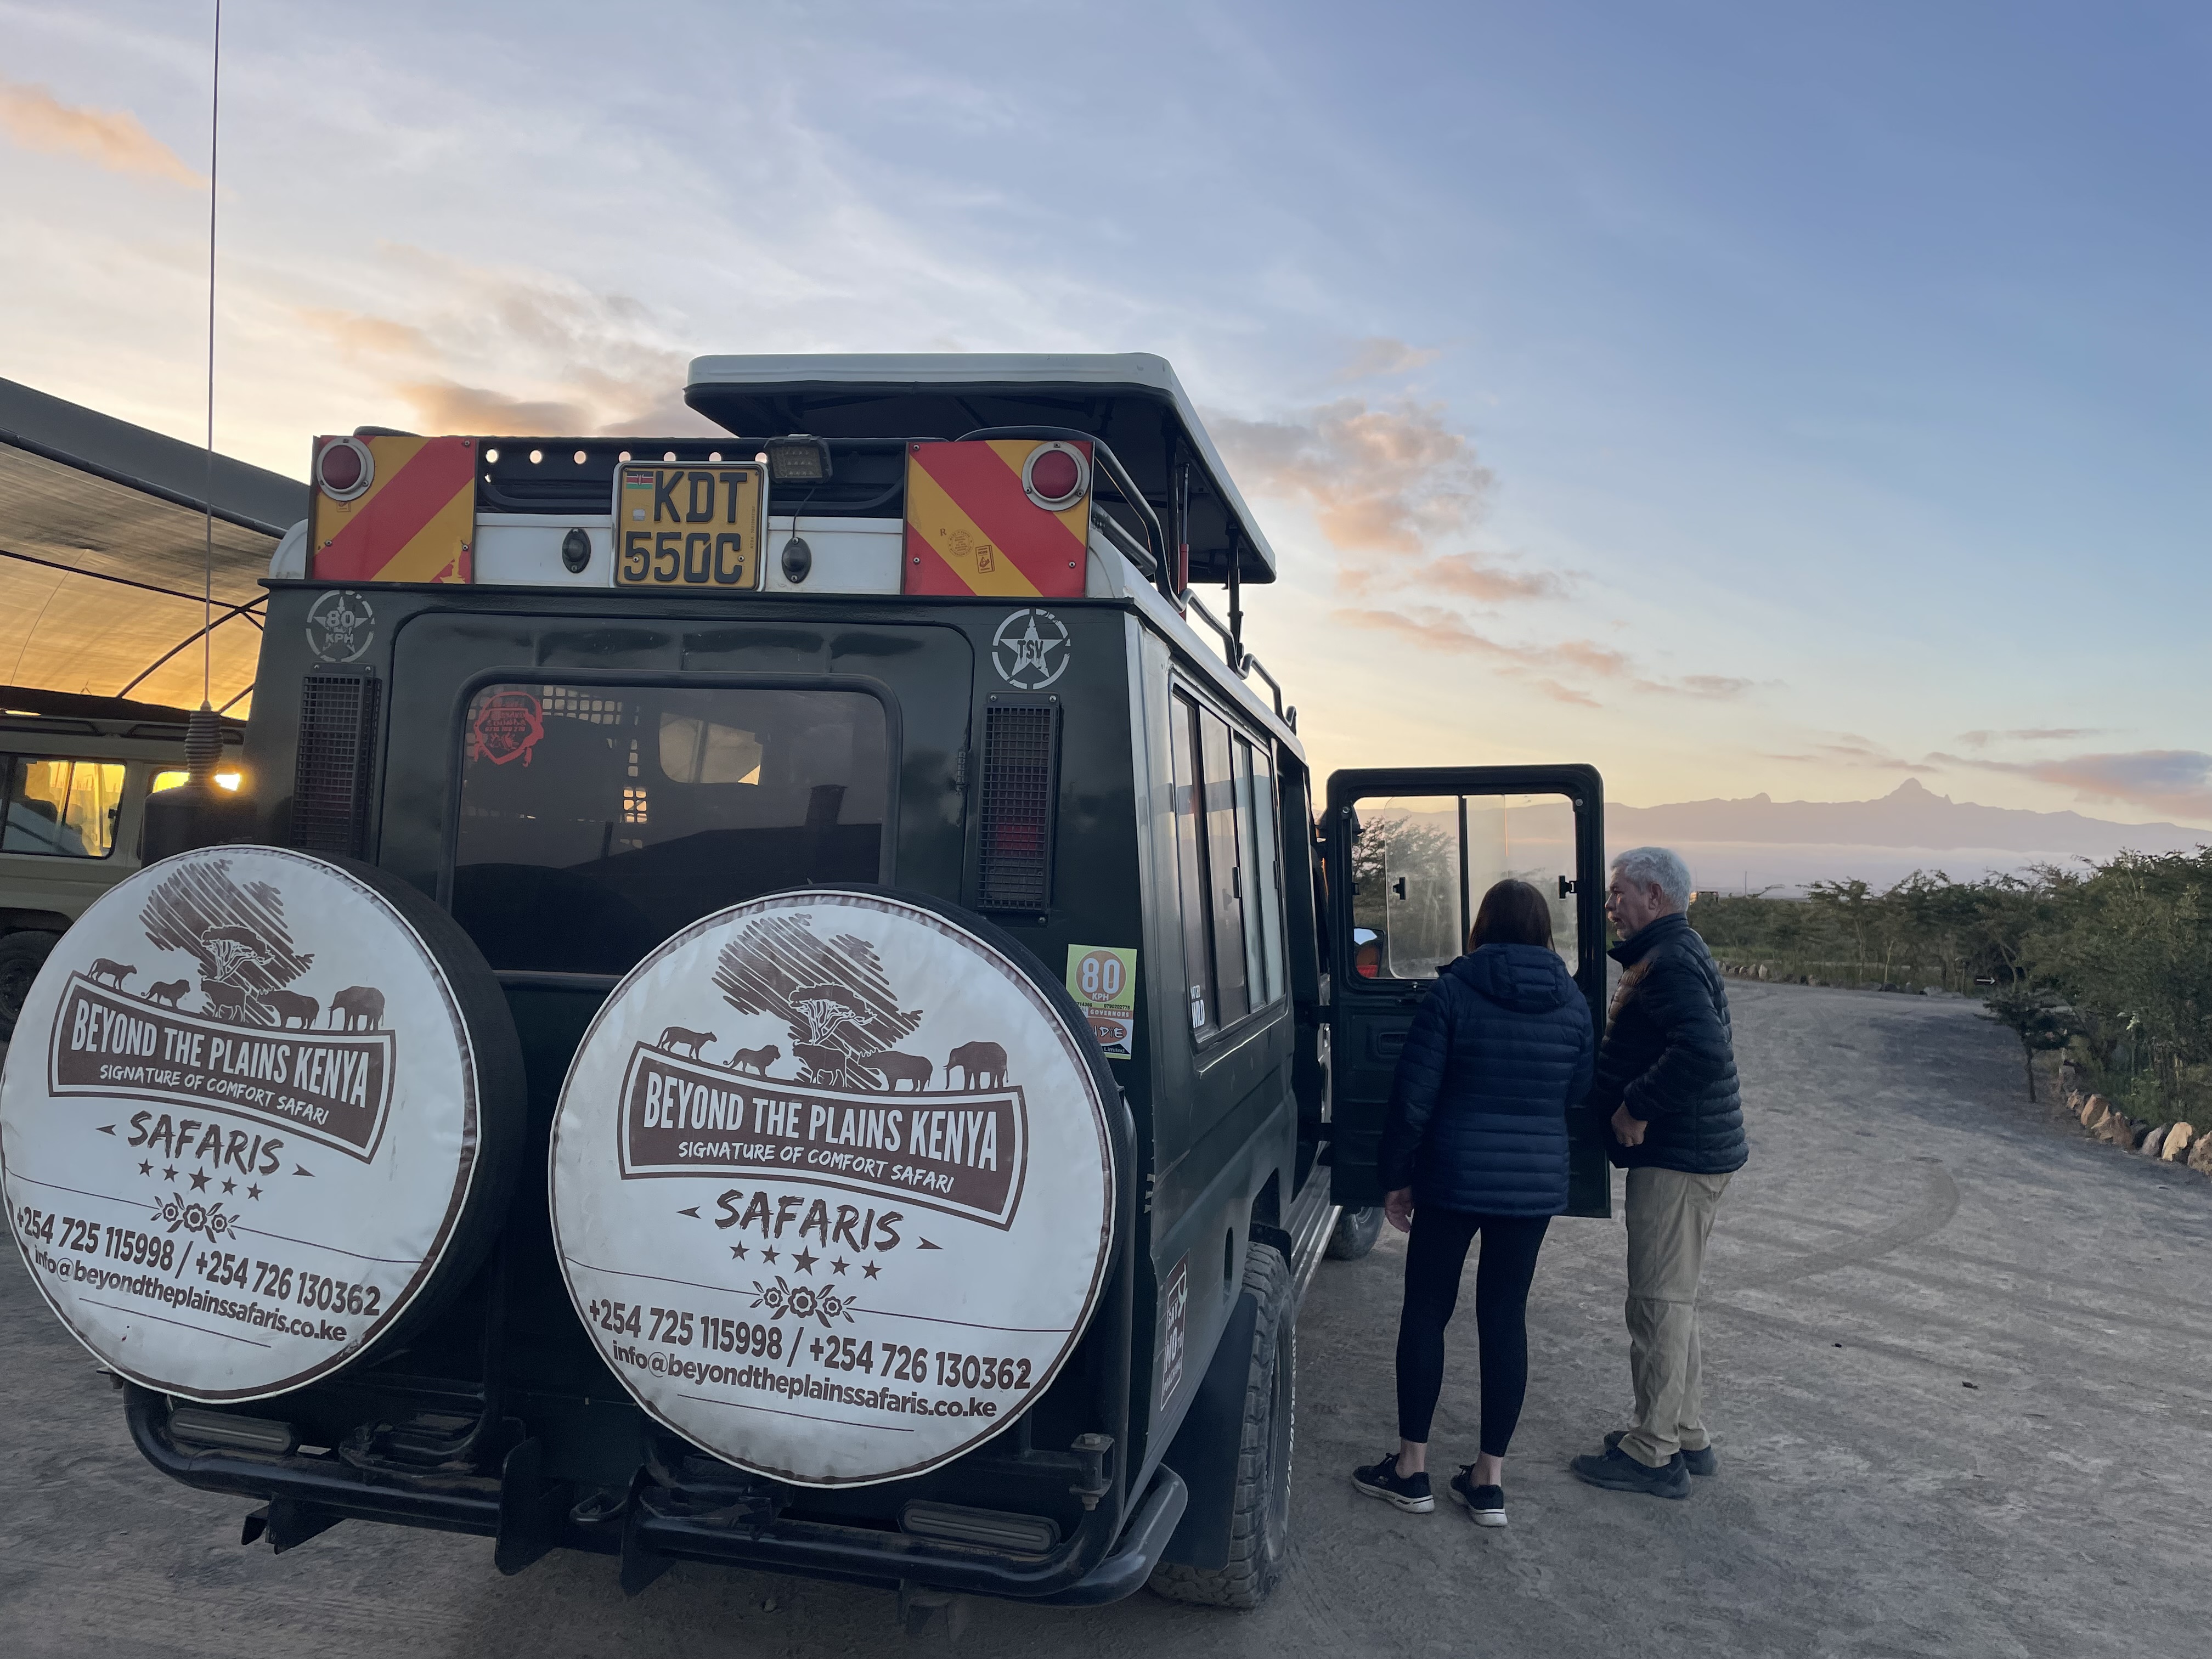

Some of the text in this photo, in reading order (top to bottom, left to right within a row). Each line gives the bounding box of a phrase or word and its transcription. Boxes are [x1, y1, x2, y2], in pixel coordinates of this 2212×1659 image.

[654, 471, 747, 524] KDT
[624, 532, 743, 584] 550C
[325, 633, 354, 644] KPH
[326, 610, 354, 627] 80
[1082, 957, 1120, 994] 80
[1092, 993, 1109, 1001] KPH
[1090, 1009, 1130, 1017] GOVERNORS
[71, 998, 369, 1108] BEYOND THE PLAINS KENYA
[100, 1065, 329, 1125] SIGNATURE OF COMFORT SAFARI
[644, 1072, 996, 1171] BEYOND THE PLAINS KENYA
[128, 1110, 284, 1177] SAFARIS
[679, 1142, 954, 1193] SIGNATURE OF COMFORT SAFARI
[715, 1189, 904, 1252] SAFARIS
[18, 1207, 55, 1244] +254
[58, 1217, 100, 1253] 725
[105, 1227, 174, 1271] 115998
[196, 1251, 249, 1290] +254
[252, 1261, 294, 1300] 726
[297, 1272, 380, 1316] 130362
[35, 1244, 348, 1342] info@beyondtheplainssafaris.co.ke
[1168, 1300, 1178, 1330] SAY
[590, 1299, 641, 1338] +254
[648, 1307, 693, 1346] 725
[701, 1316, 782, 1359] 115998
[810, 1335, 873, 1374] +254
[881, 1343, 928, 1383] 726
[936, 1352, 1031, 1390] 130362
[1165, 1327, 1178, 1373] NO
[613, 1340, 997, 1417] info@beyondtheplainssafaris.co.ke
